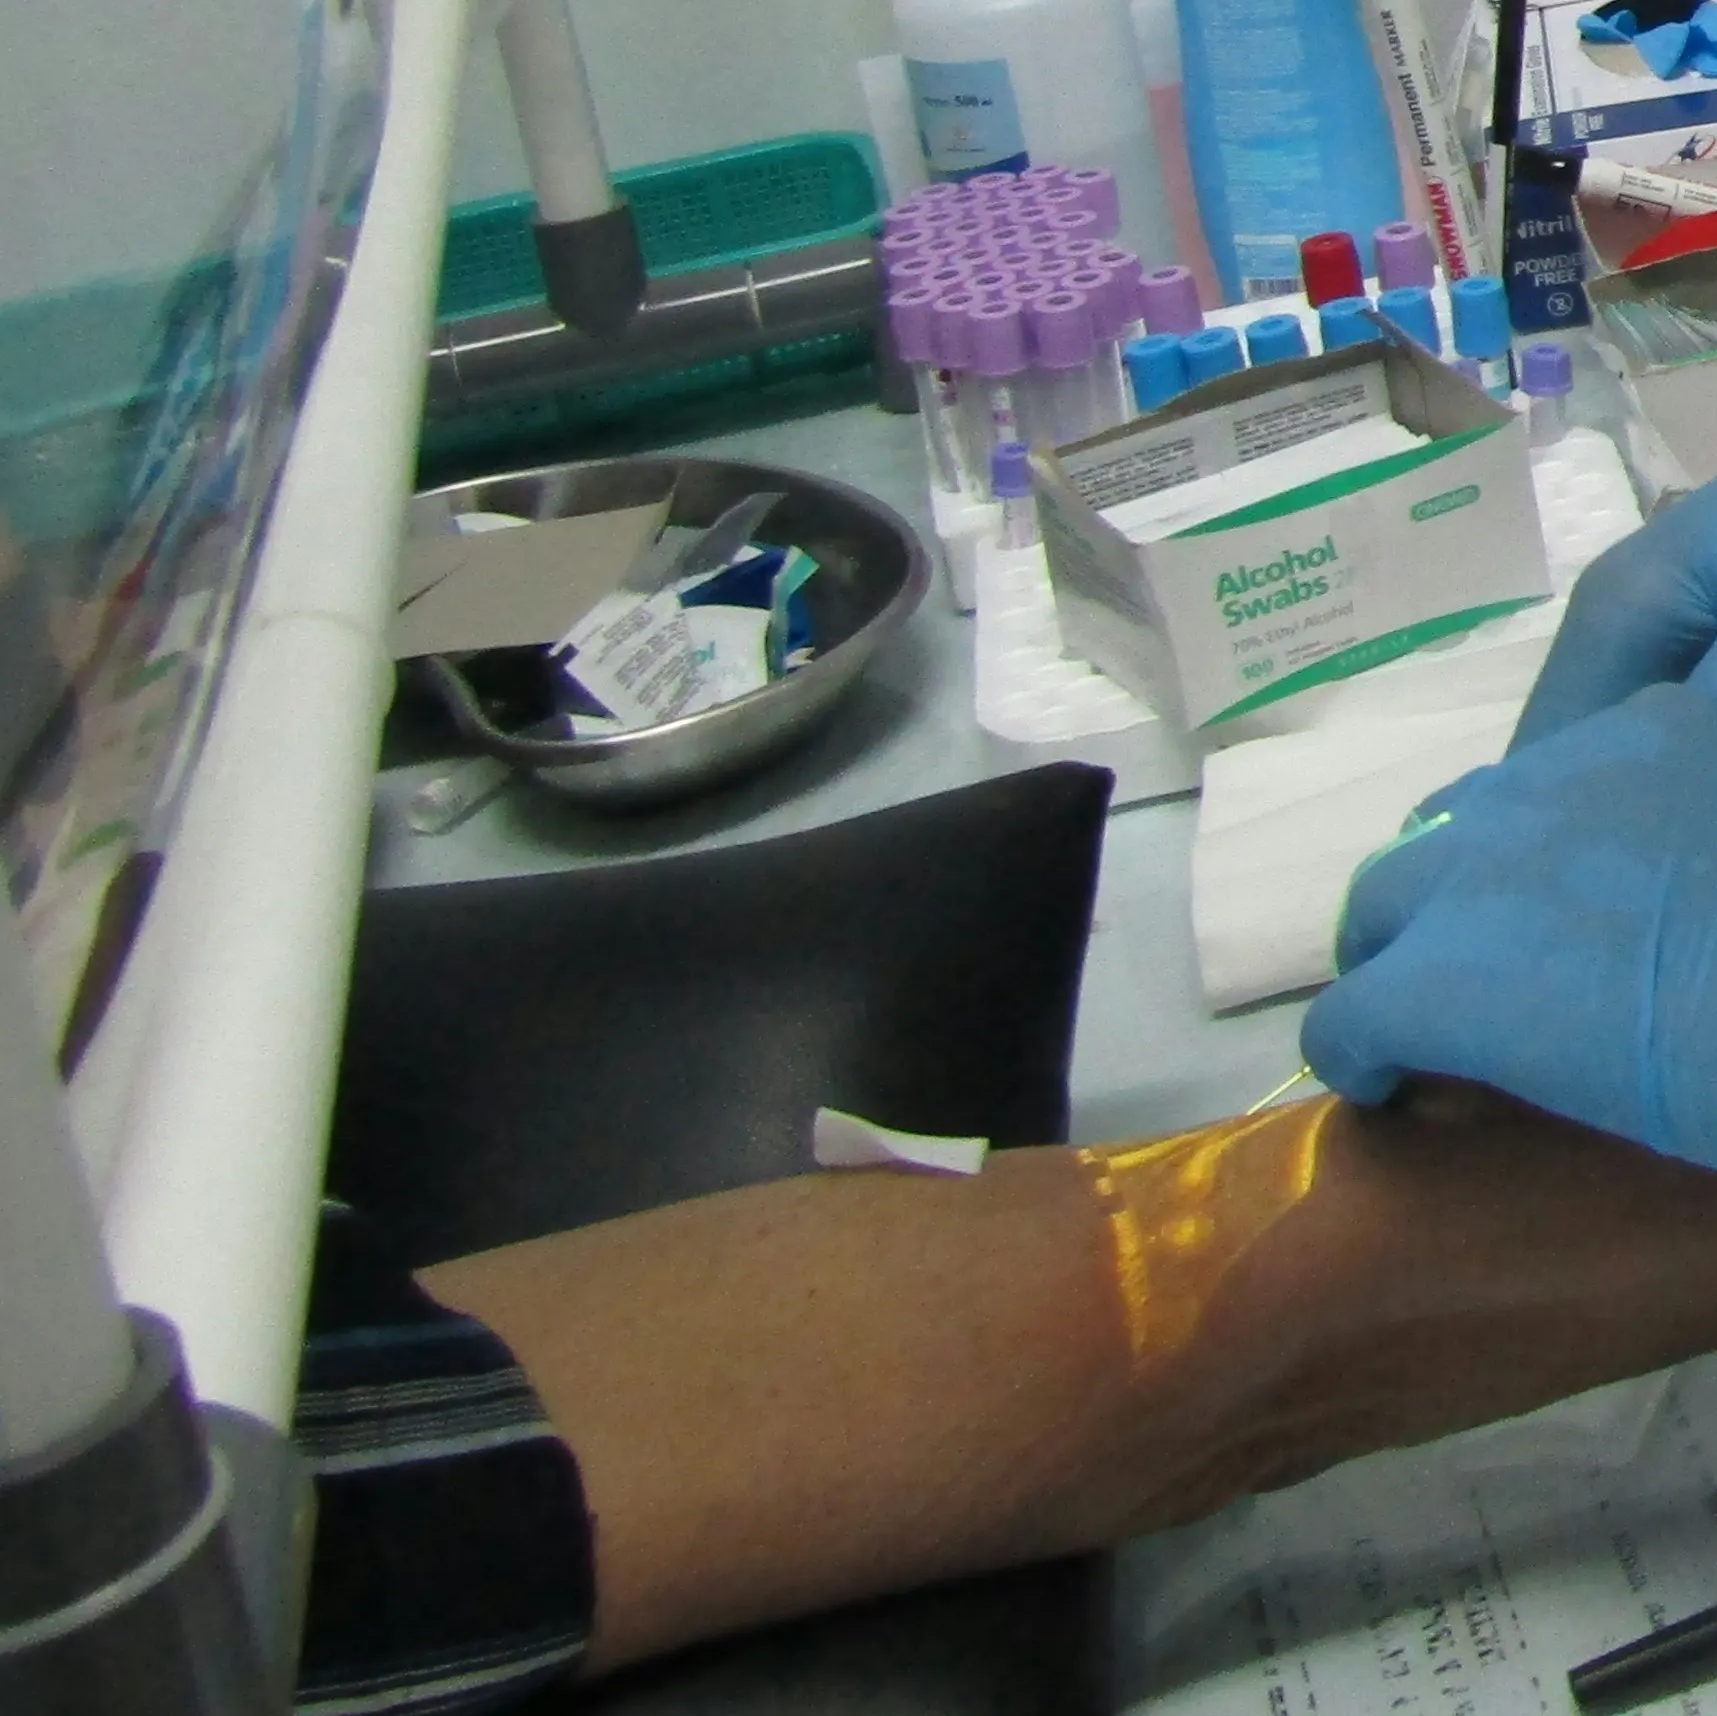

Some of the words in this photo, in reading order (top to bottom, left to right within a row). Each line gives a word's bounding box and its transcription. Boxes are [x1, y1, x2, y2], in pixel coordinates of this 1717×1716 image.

[1379, 8, 1409, 68] MARKER
[1397, 73, 1436, 167] Permanent
[1427, 180, 1468, 282] SNOWMAN
[1534, 267, 1579, 287] FREE
[1214, 534, 1339, 602] Alcohol
[1221, 574, 1330, 629] Swabs
